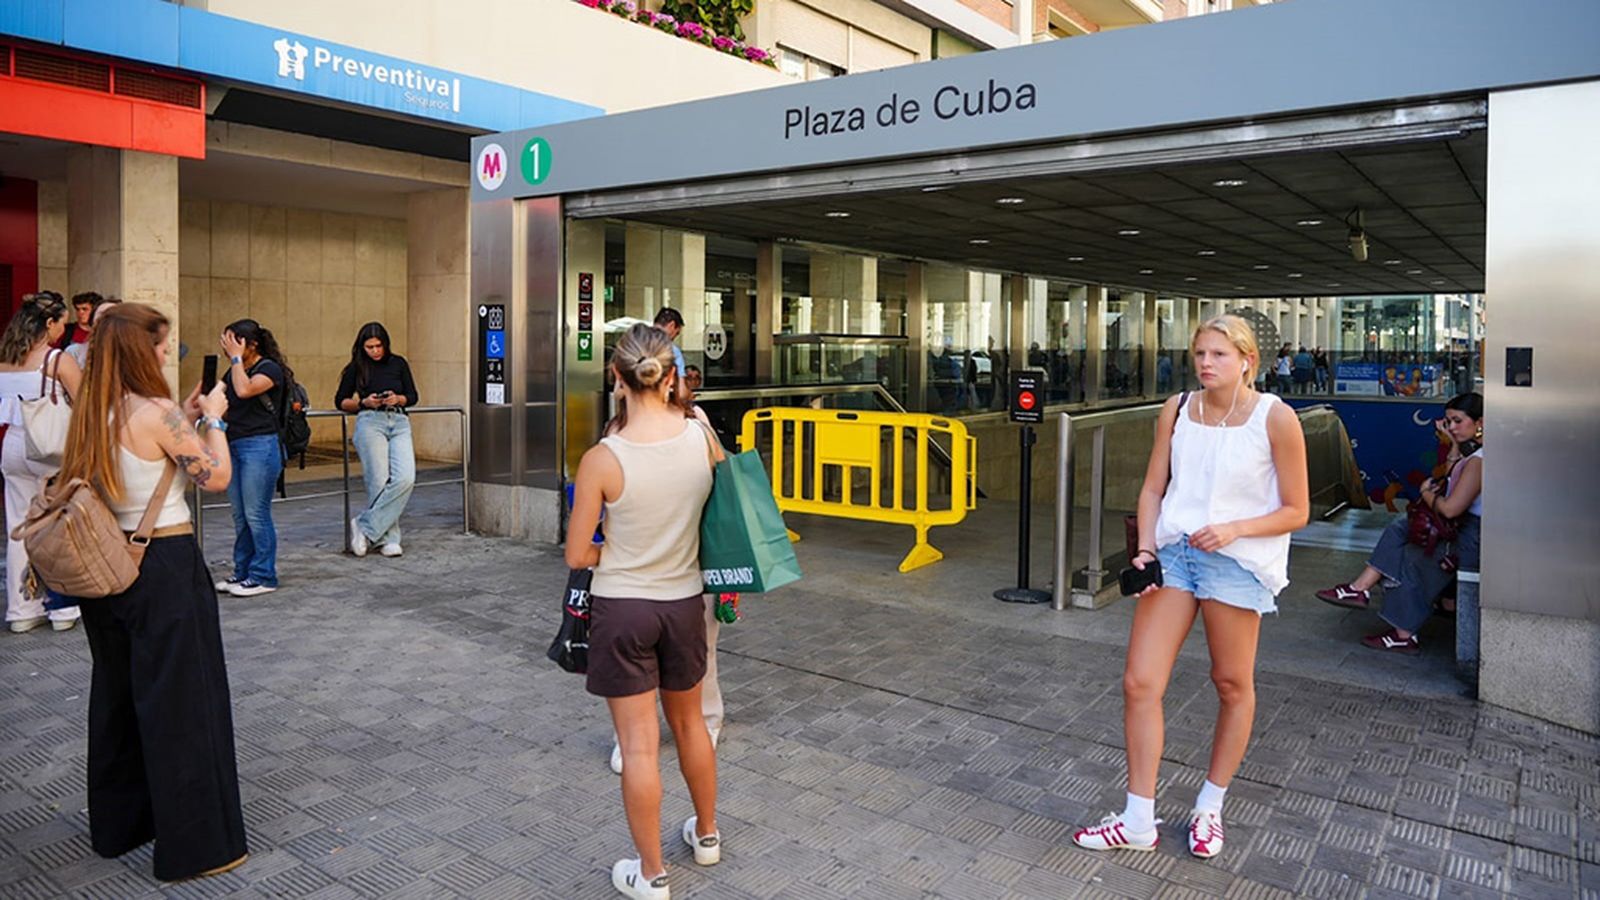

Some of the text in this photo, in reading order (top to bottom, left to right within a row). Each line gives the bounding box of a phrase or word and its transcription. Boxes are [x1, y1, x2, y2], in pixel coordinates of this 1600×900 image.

[314, 47, 449, 97] Preventiva
[404, 91, 449, 110] Seguros
[784, 79, 1037, 139] Plaza de Cuba
[483, 152, 501, 178] M
[529, 143, 539, 180] 1
